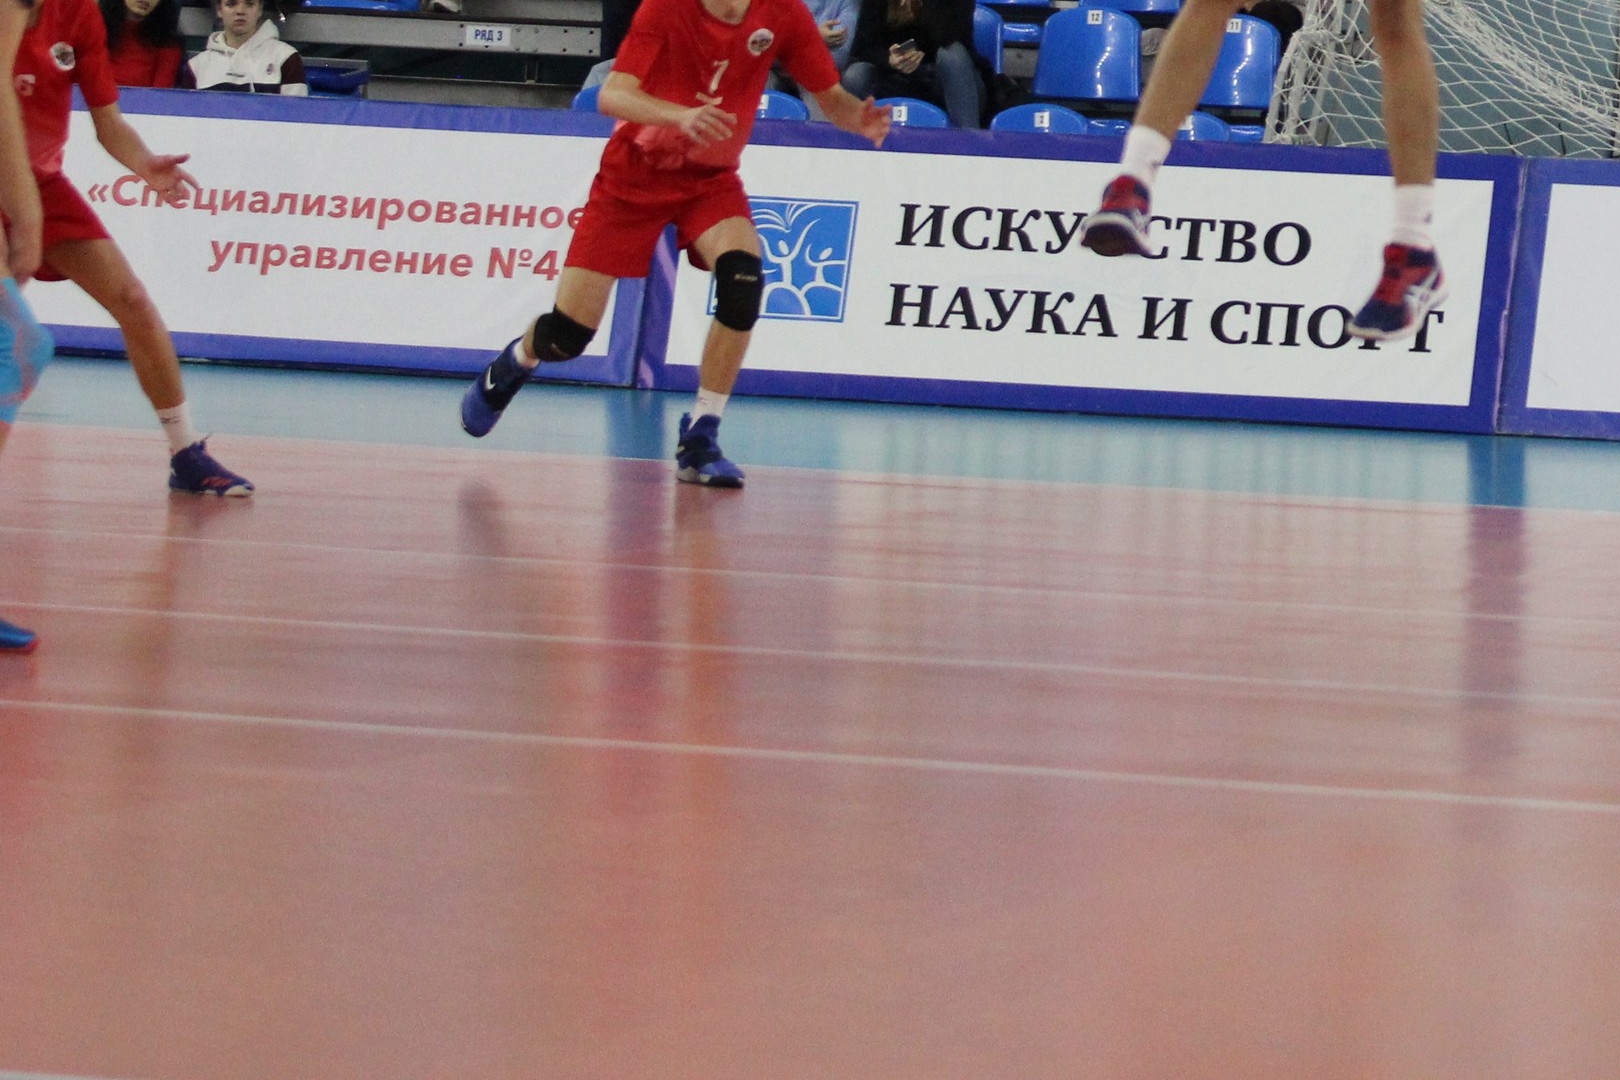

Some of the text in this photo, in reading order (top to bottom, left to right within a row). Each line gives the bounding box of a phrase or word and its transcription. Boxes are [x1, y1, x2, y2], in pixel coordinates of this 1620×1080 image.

[474, 29, 504, 42] РЯД 3
[207, 240, 474, 277] управление
[895, 203, 1312, 266] ИСКУСТВО
[884, 282, 1445, 353] НАУКА И СПОТ
